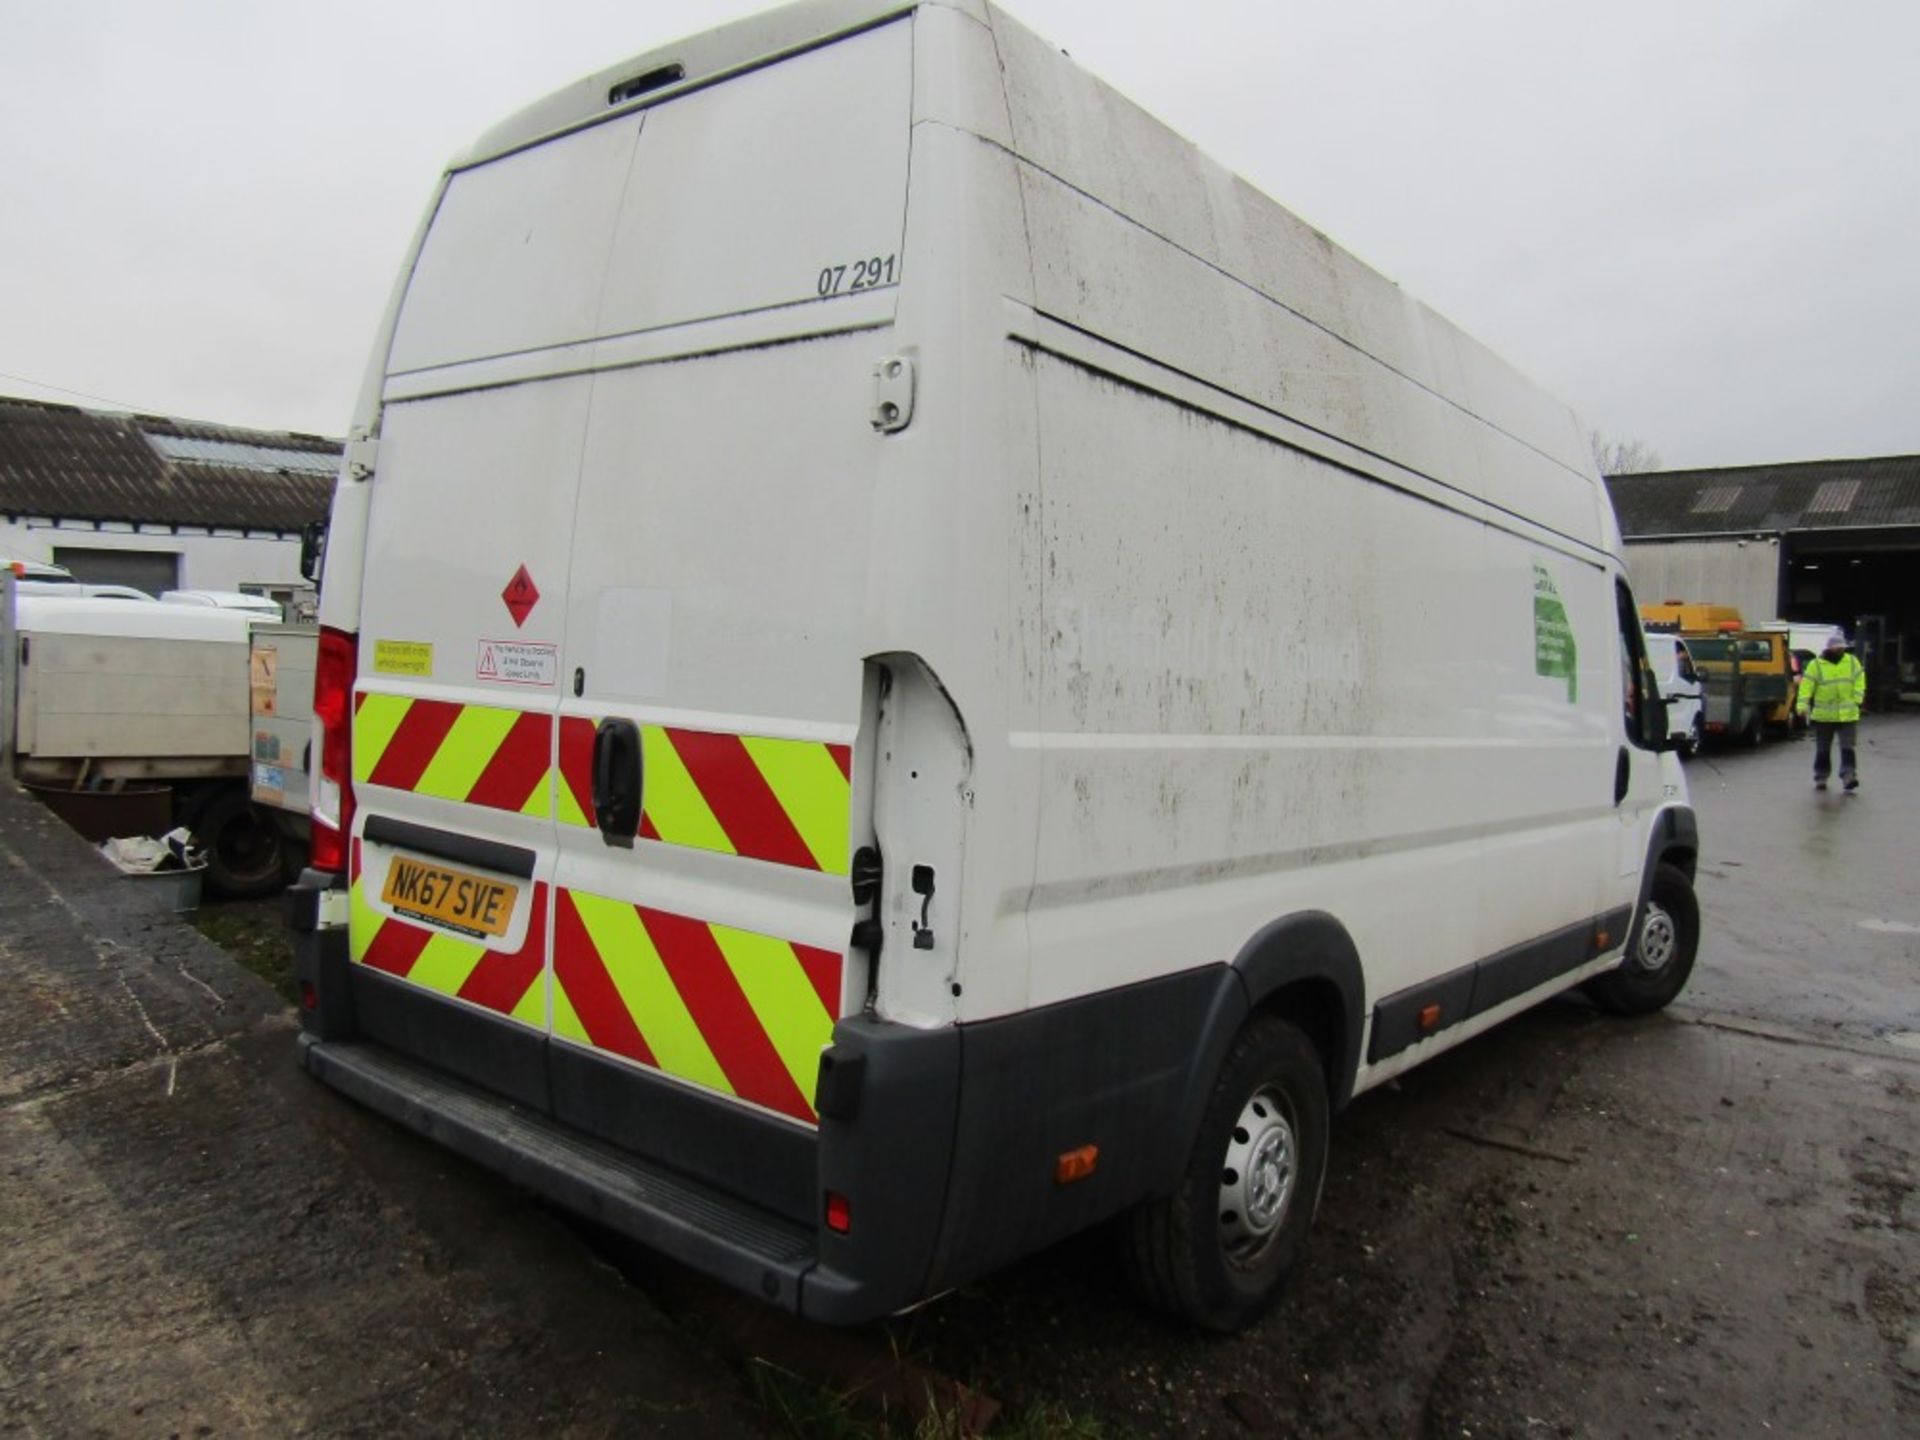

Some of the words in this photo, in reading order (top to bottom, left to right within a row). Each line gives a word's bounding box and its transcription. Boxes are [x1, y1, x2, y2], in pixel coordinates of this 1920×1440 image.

[818, 265, 847, 296] 07
[850, 253, 895, 290] 291
[392, 863, 454, 910] NK67
[453, 879, 504, 925] SVE
